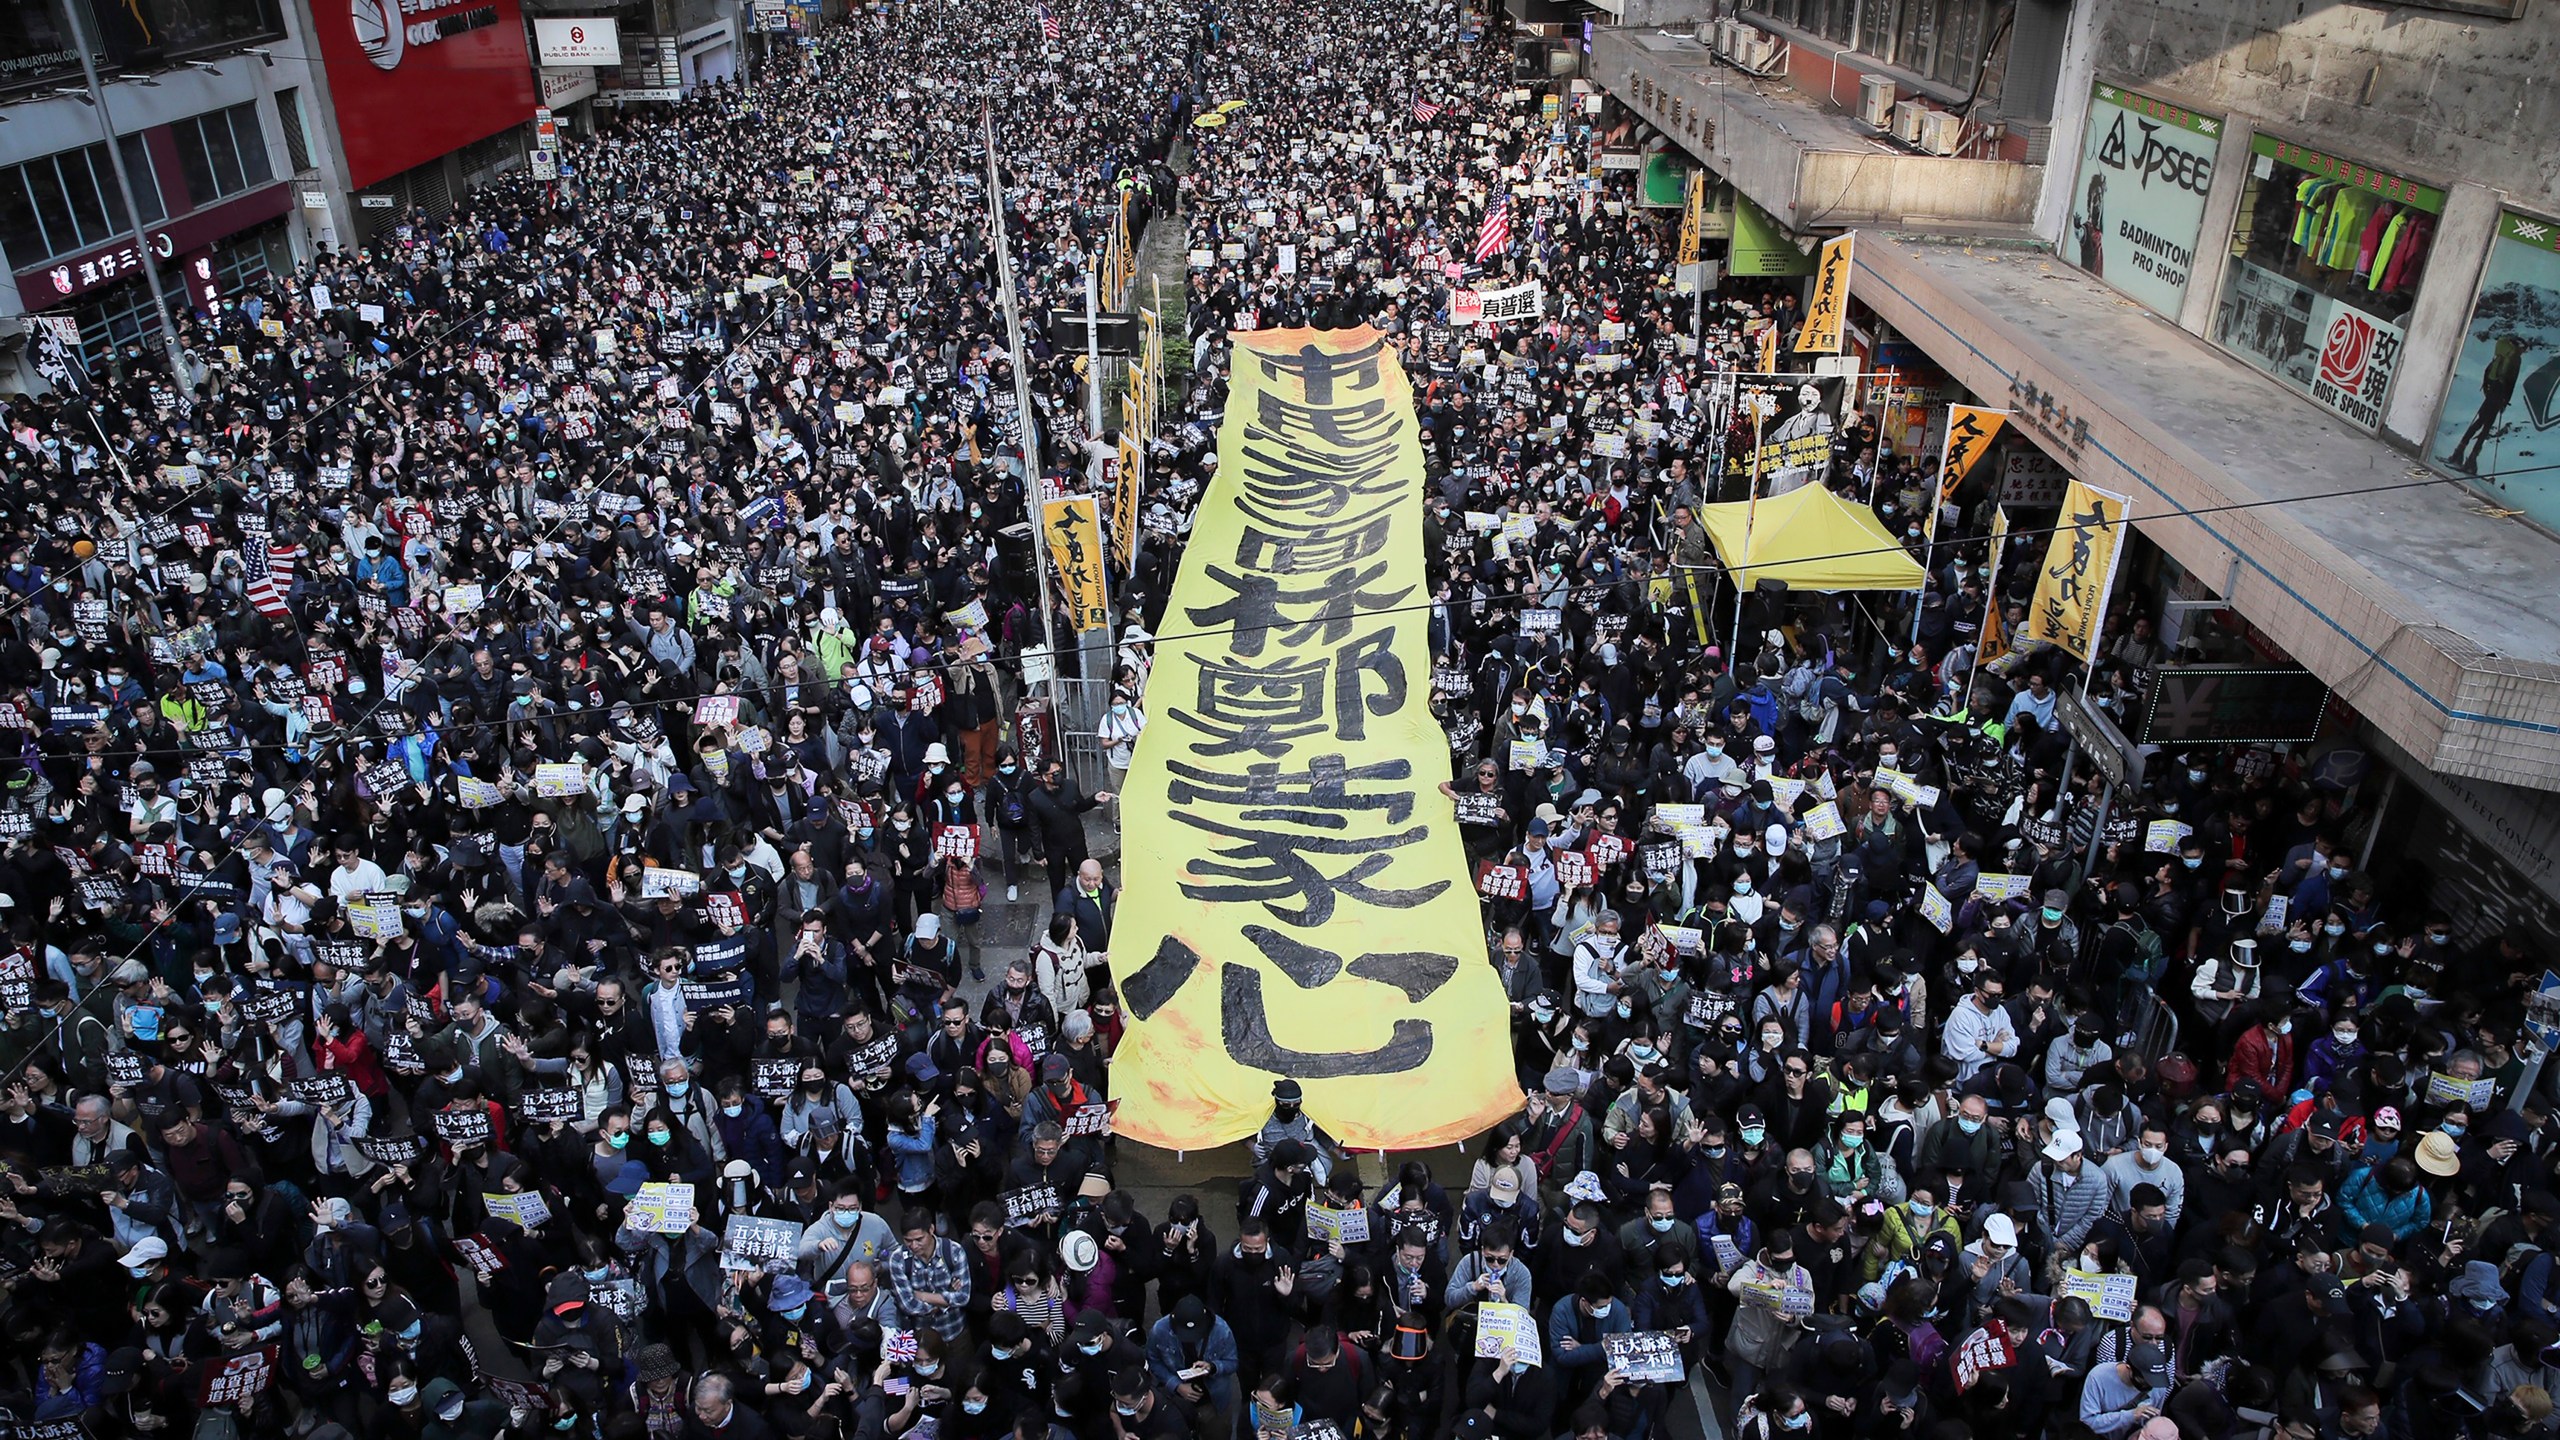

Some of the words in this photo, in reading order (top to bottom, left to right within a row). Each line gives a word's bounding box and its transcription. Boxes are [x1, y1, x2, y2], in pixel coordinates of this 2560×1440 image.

[407, 19, 441, 46] OCBC
[2119, 219, 2191, 269] BADMINTON
[2132, 251, 2154, 275] PRO
[2155, 260, 2186, 288] SHOP
[1482, 290, 1536, 319] 真普選
[2362, 330, 2399, 408] 玫瑰
[1740, 382, 1768, 391] Butcher
[1770, 383, 1793, 391] Carrie
[2312, 379, 2339, 407] ROSE
[2339, 393, 2379, 429] SPORTS
[1459, 795, 1497, 807] 五大訴求
[2464, 790, 2494, 823] FEET
[2495, 816, 2555, 870] CONCEPT
[316, 946, 363, 957] 五大訴求
[850, 1032, 897, 1062] 五大訴求
[848, 1048, 900, 1076] 缺一不可
[292, 1076, 343, 1091] 五大訴求
[522, 1090, 578, 1105] 五大訴求
[522, 1102, 579, 1115] 缺一不可
[434, 1112, 487, 1127] 五大訴求
[1006, 1188, 1057, 1206] 五大訴求
[1008, 1198, 1060, 1217] 堅持到底
[735, 1224, 793, 1243] 五大訴求
[732, 1239, 791, 1260] 堅持到底
[1611, 1337, 1672, 1354] 五大訴求
[1613, 1351, 1675, 1371] 缺一不可
